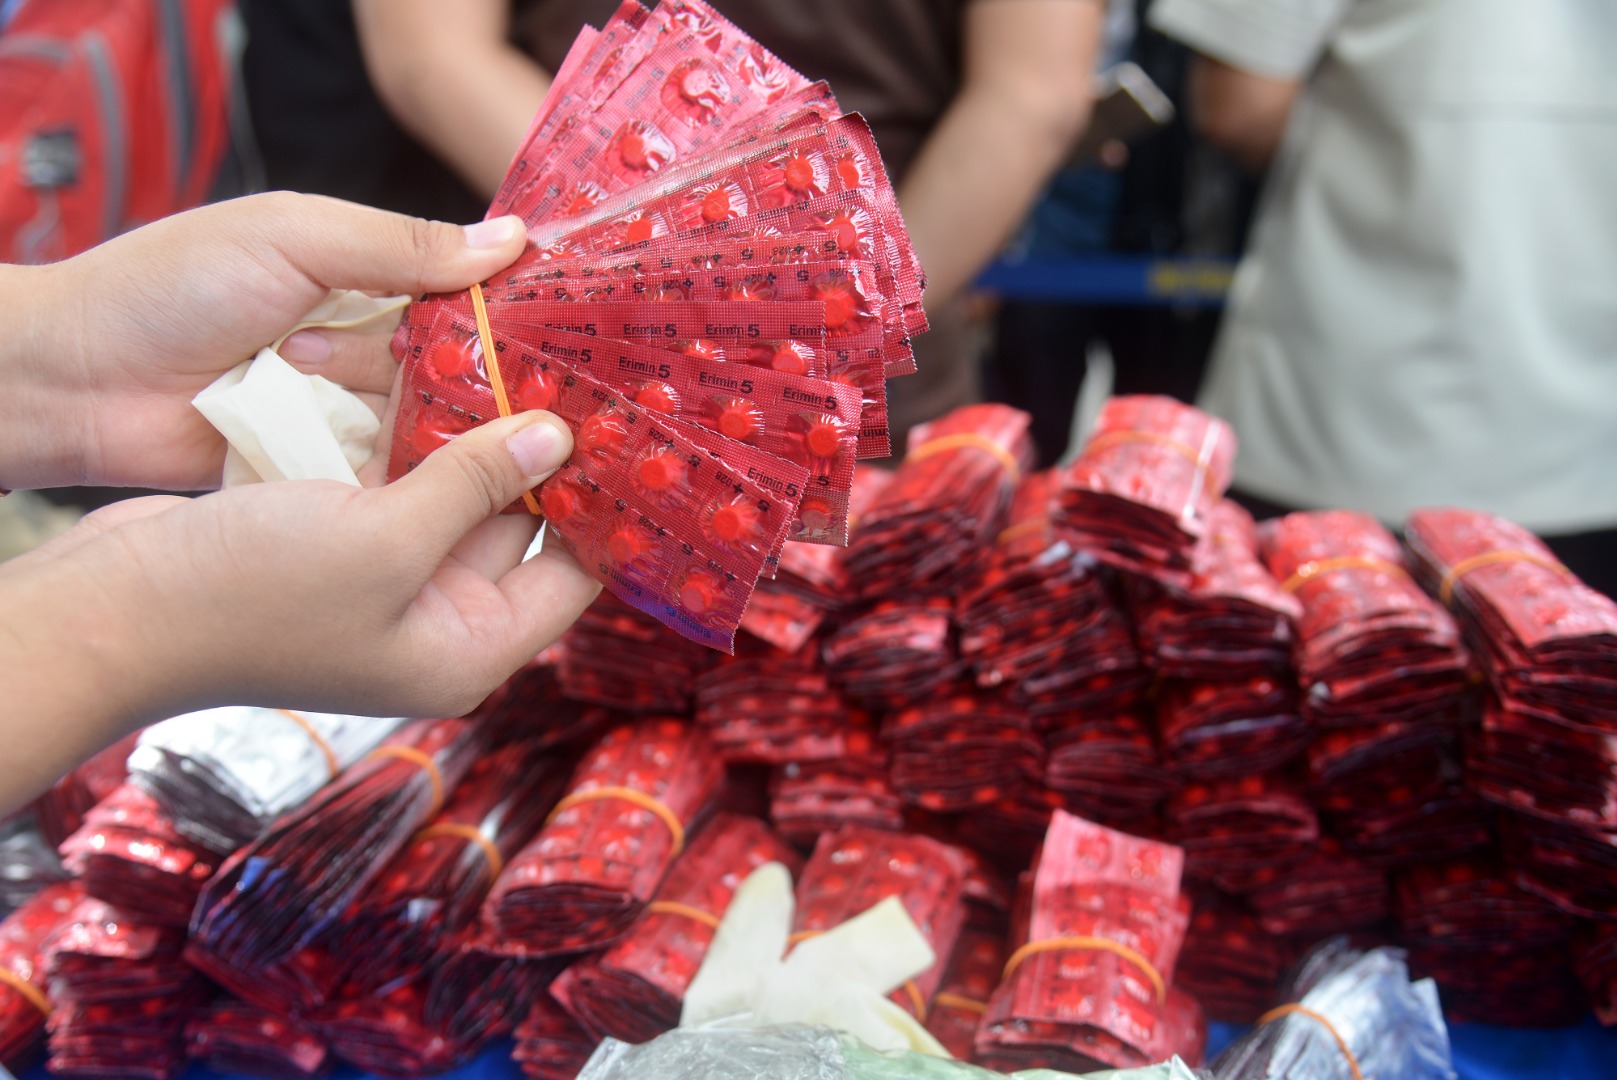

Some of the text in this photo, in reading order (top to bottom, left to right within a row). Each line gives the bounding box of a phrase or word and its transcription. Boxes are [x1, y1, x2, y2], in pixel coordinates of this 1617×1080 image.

[714, 276, 726, 288] 5
[797, 270, 808, 282] 5
[584, 324, 596, 336] 5
[624, 324, 662, 337] Erimin
[664, 324, 677, 338] 5
[706, 324, 744, 337] Erimin
[748, 324, 760, 338] 5
[790, 324, 825, 336] Erimi
[496, 341, 507, 352] 5
[541, 341, 837, 410] Erimin 5 Erimin 5 Erimin 5 Erimin 5
[648, 427, 665, 442] 028
[715, 471, 732, 487] 028
[747, 467, 798, 498] Erimin 5
